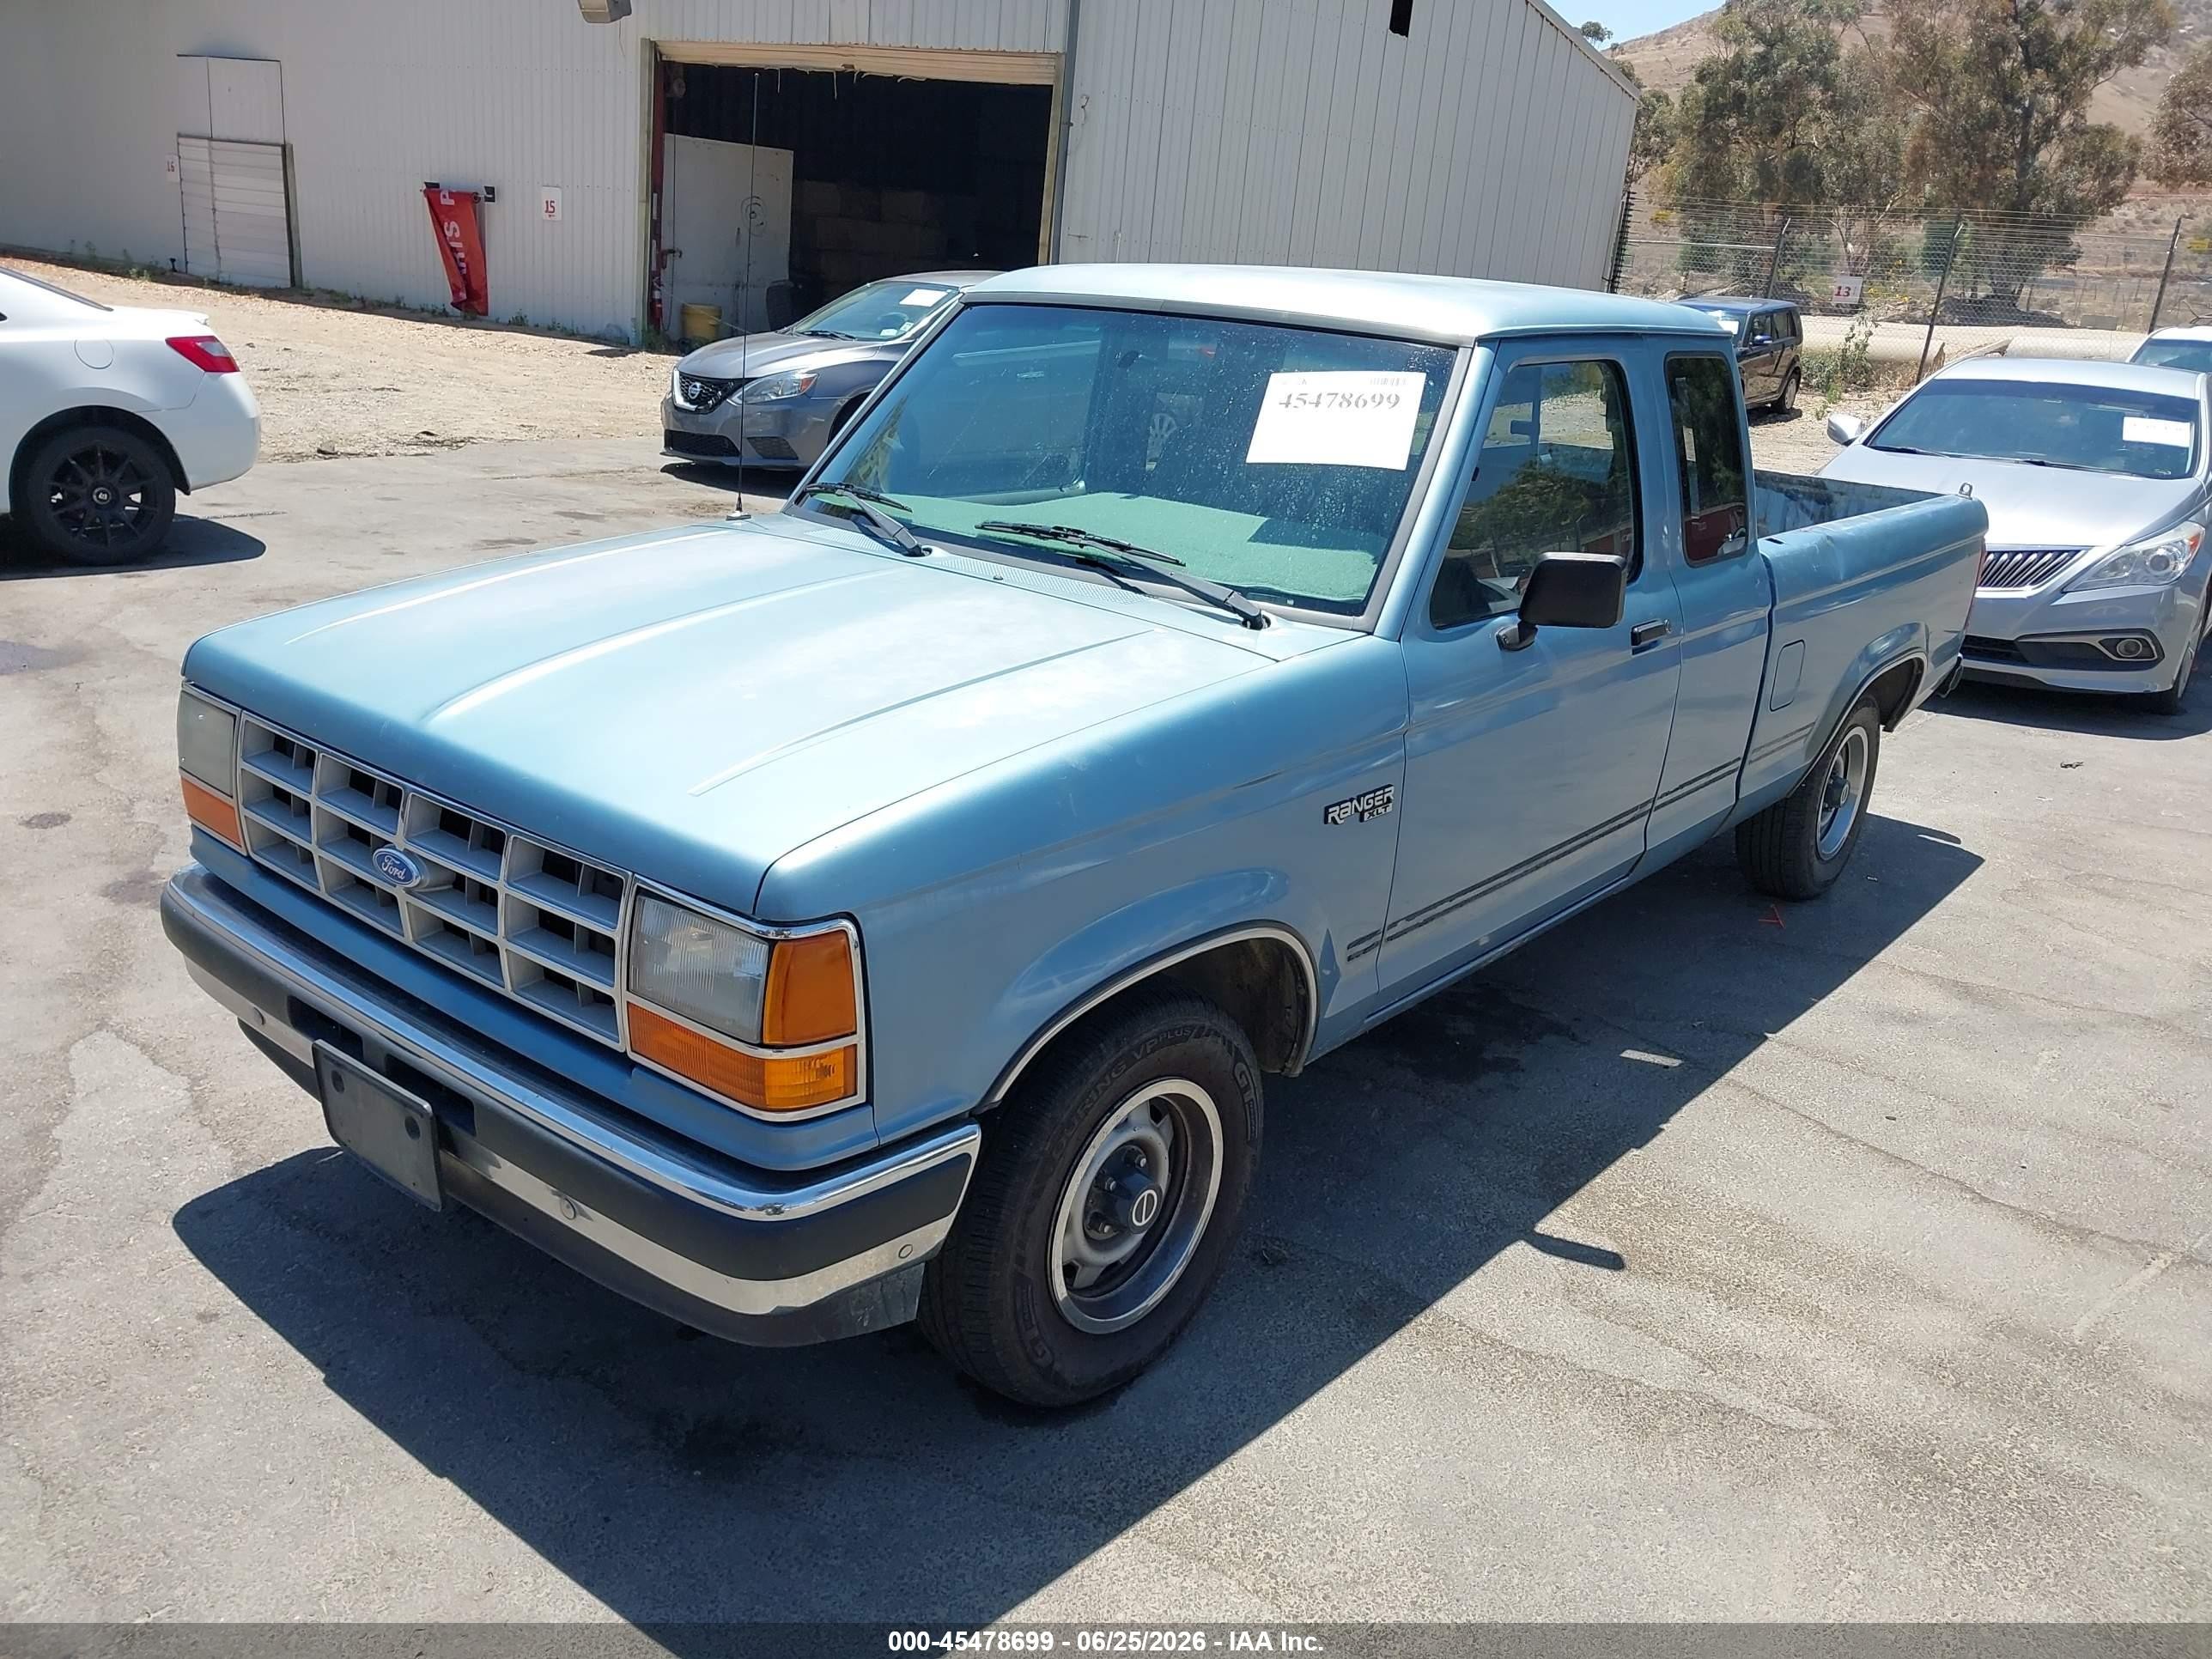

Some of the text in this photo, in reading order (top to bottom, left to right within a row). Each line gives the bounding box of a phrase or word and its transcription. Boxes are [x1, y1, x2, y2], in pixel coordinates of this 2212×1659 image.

[544, 199, 556, 214] 15
[1834, 285, 1851, 297] 13
[1279, 392, 1401, 410] 45478699
[1326, 785, 1395, 825] RANGER
[381, 854, 407, 880] Ford
[1159, 1028, 1193, 1042] PLUS
[1234, 1061, 1256, 1104] GT
